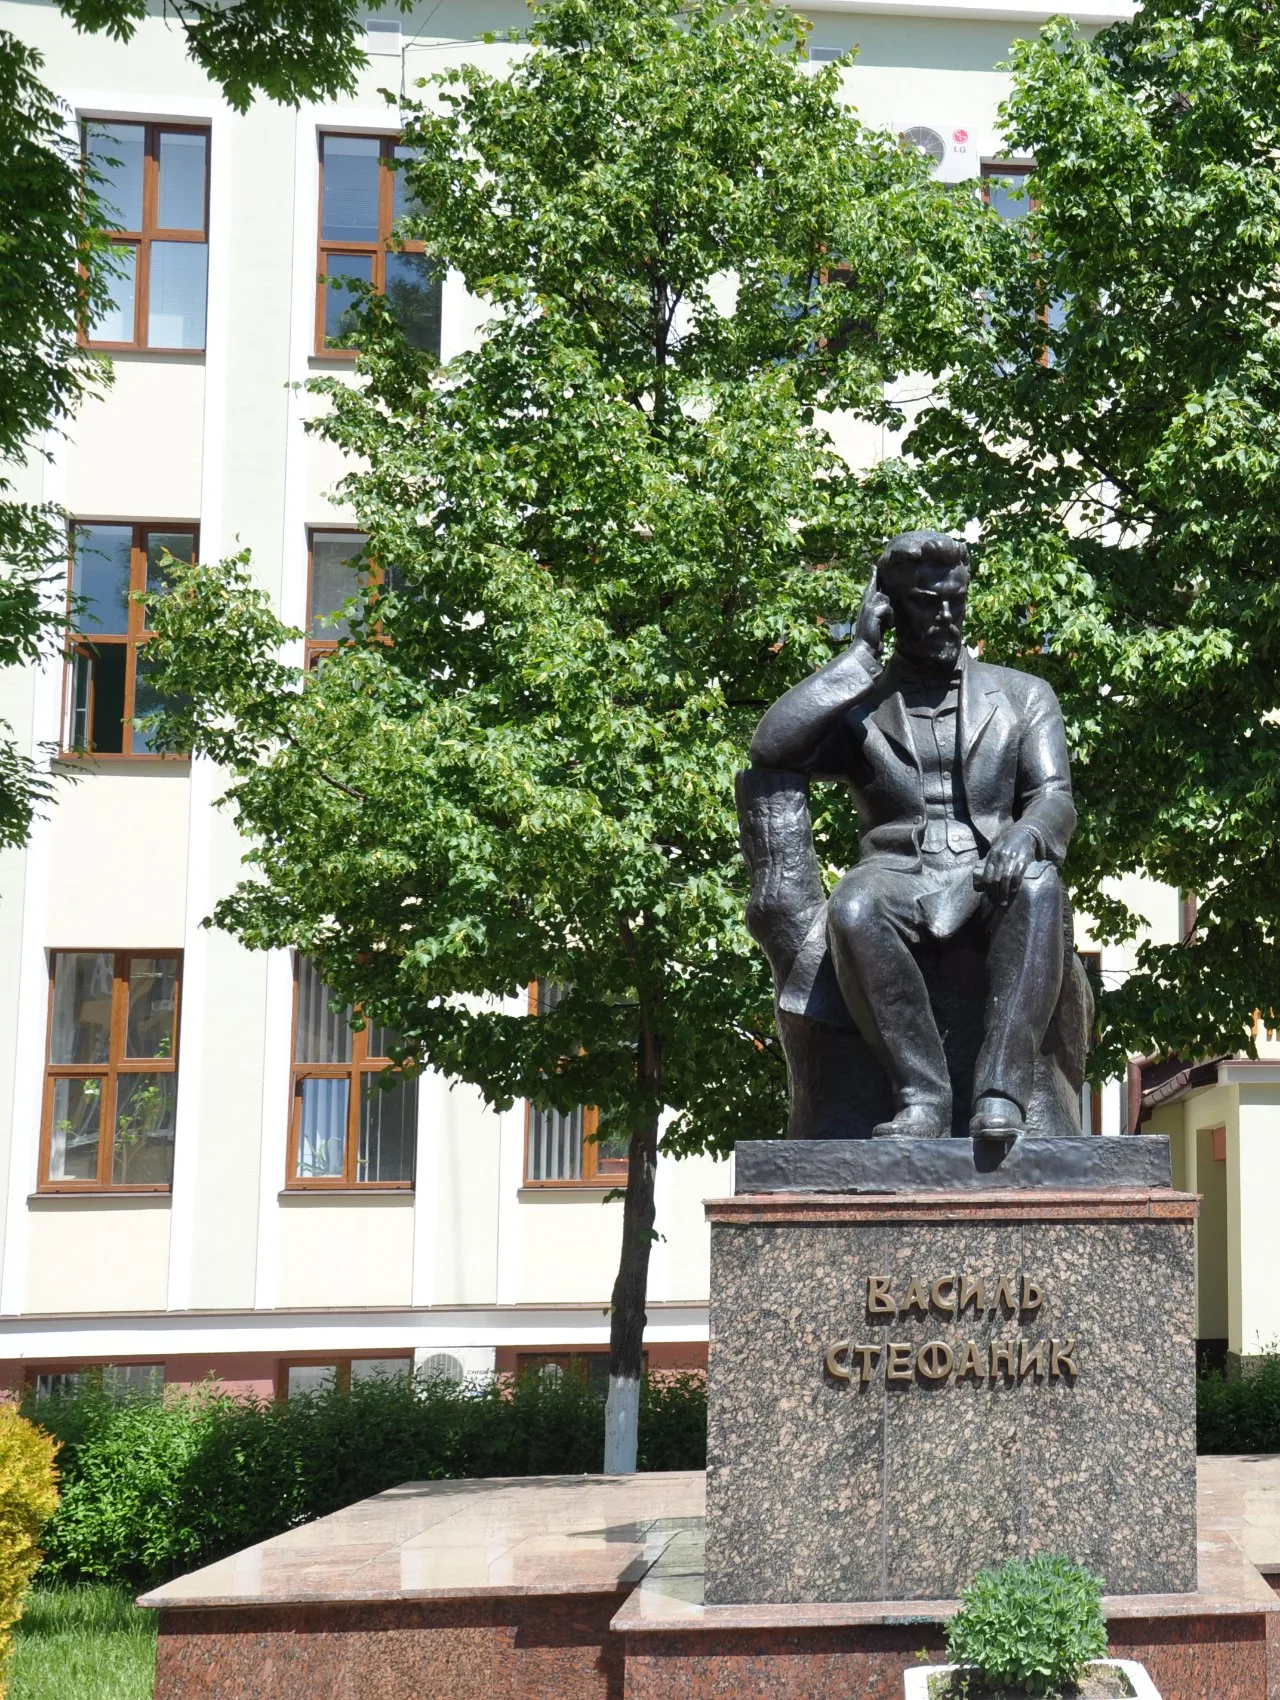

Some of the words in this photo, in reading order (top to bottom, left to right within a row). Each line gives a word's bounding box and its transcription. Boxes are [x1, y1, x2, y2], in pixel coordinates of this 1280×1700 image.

[953, 145, 966, 153] LG
[867, 1275, 1043, 1313] ВАСИЛЬ
[826, 1338, 1079, 1381] СТЕФАНИК
